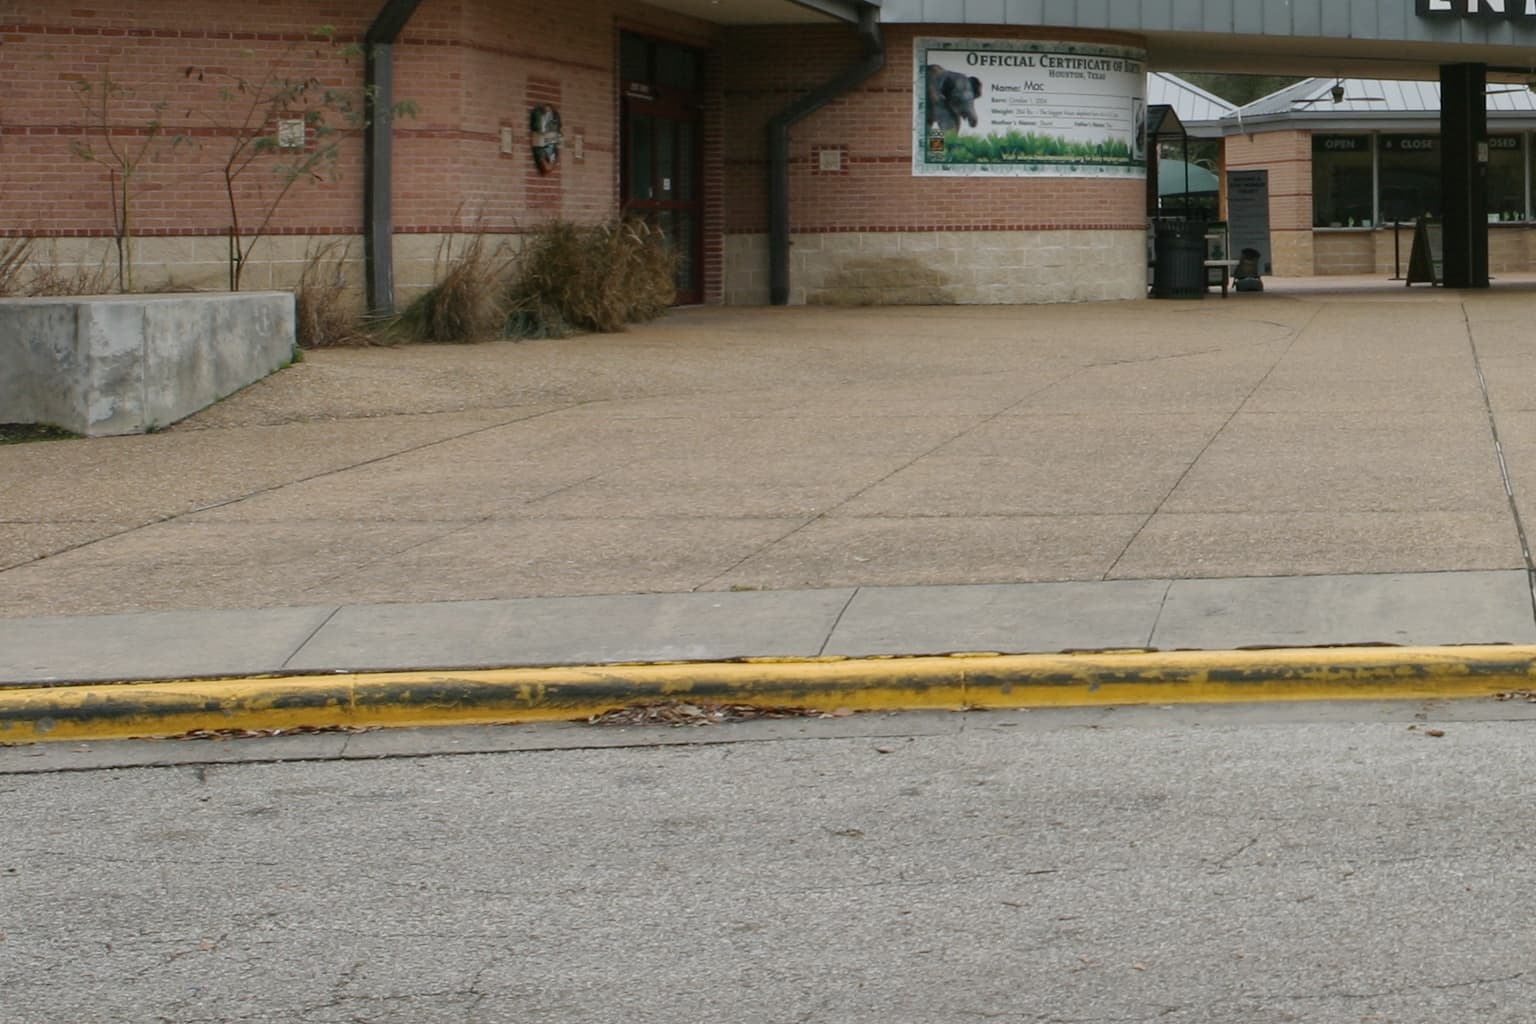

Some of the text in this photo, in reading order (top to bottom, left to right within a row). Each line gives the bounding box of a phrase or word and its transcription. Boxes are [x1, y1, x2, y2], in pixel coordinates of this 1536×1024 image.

[966, 52, 1036, 67] OFFICIAL
[1040, 54, 1110, 72] CERTIFICATE
[991, 80, 1044, 93] Name: Mac
[1325, 139, 1355, 149] OPEN
